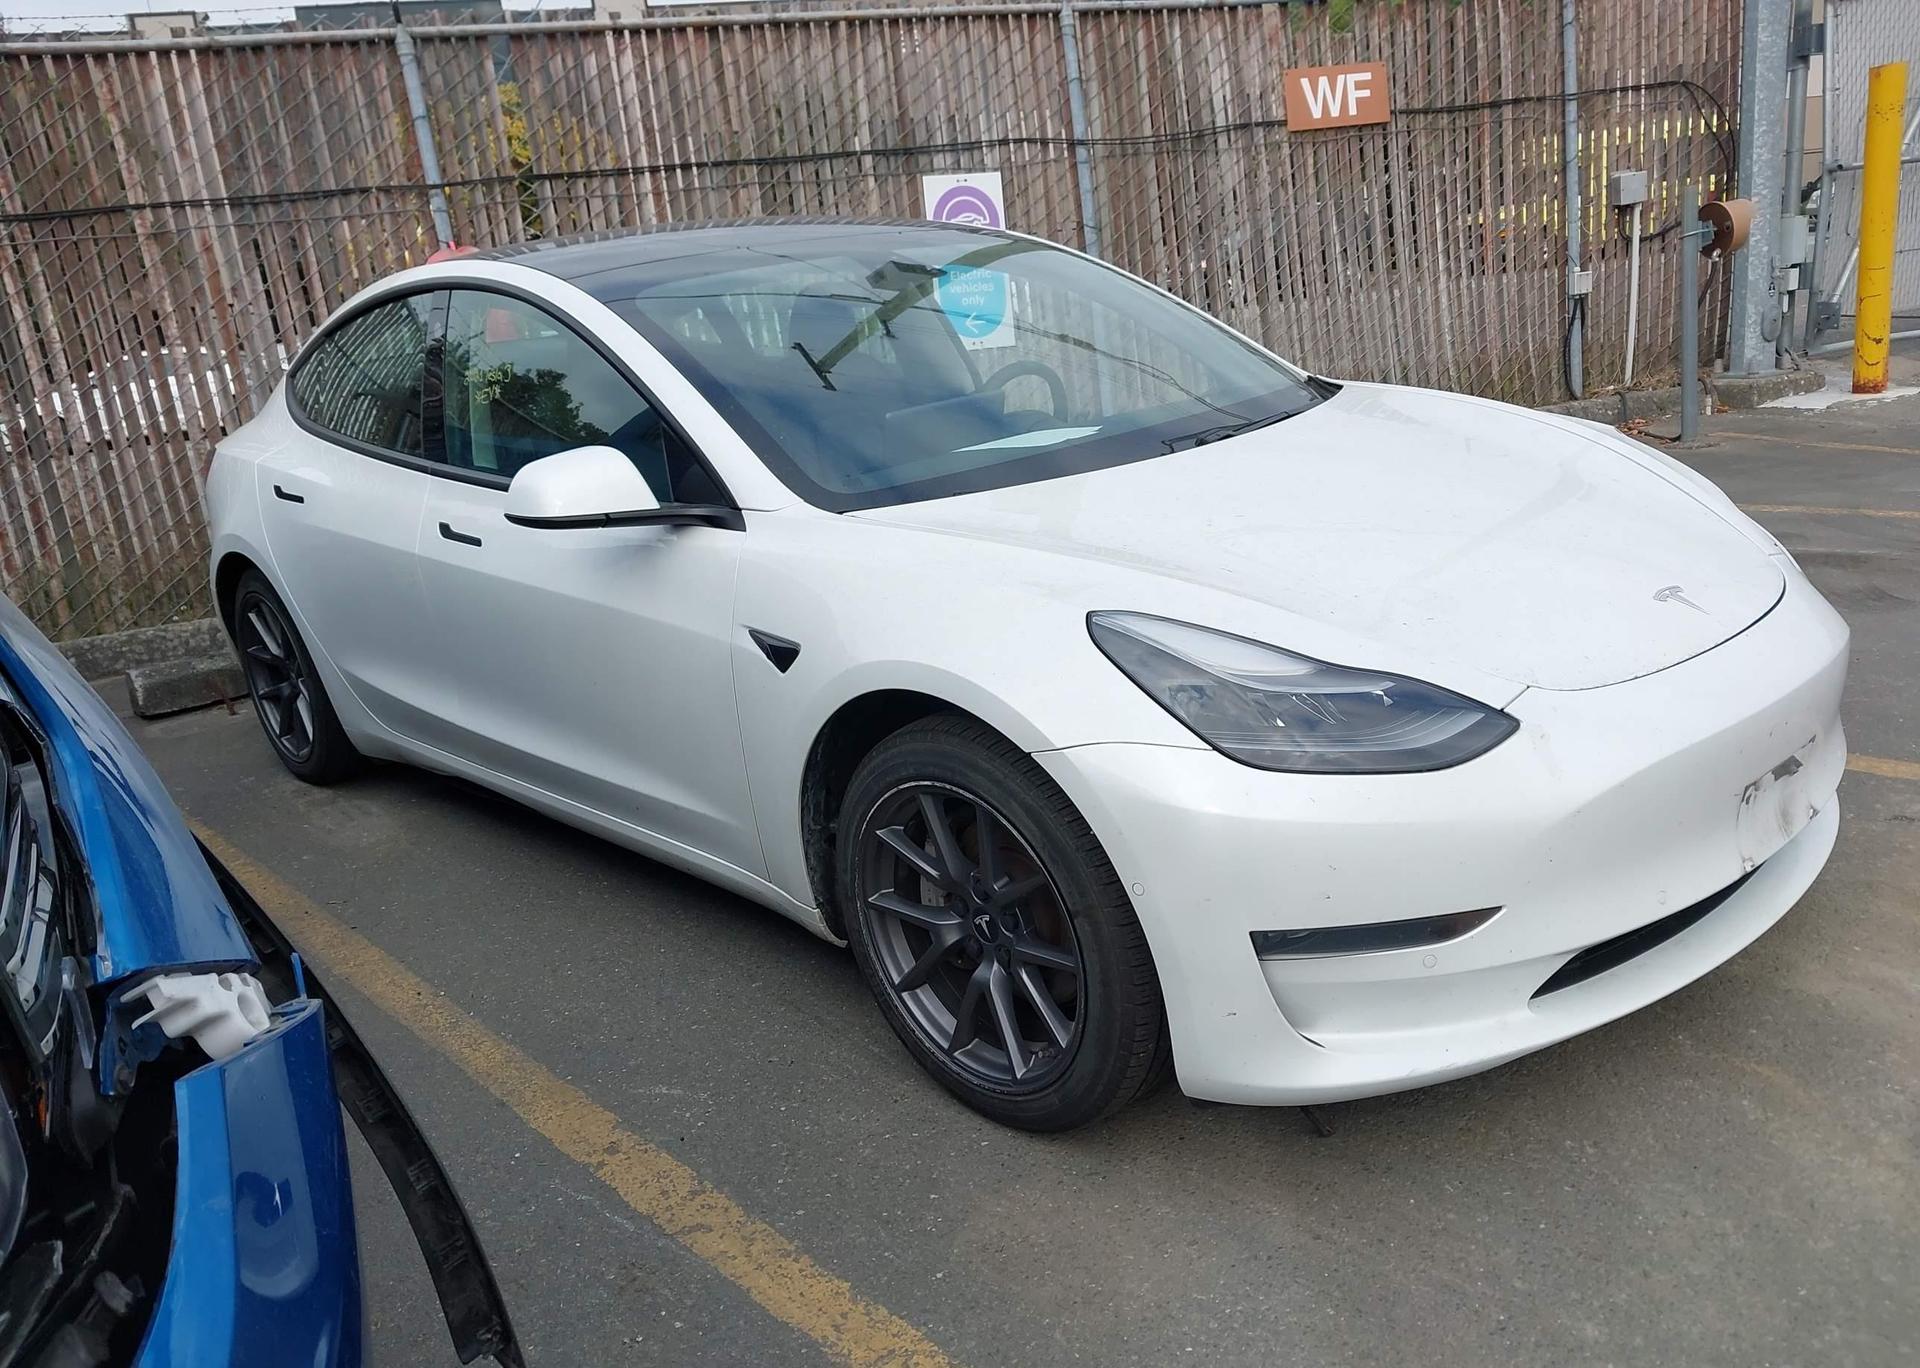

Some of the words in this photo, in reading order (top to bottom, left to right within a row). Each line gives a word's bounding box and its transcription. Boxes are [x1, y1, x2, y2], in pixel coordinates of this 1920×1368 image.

[1300, 71, 1372, 119] WF
[950, 270, 992, 281] Electric
[950, 281, 994, 293] vehicles
[961, 294, 985, 306] only
